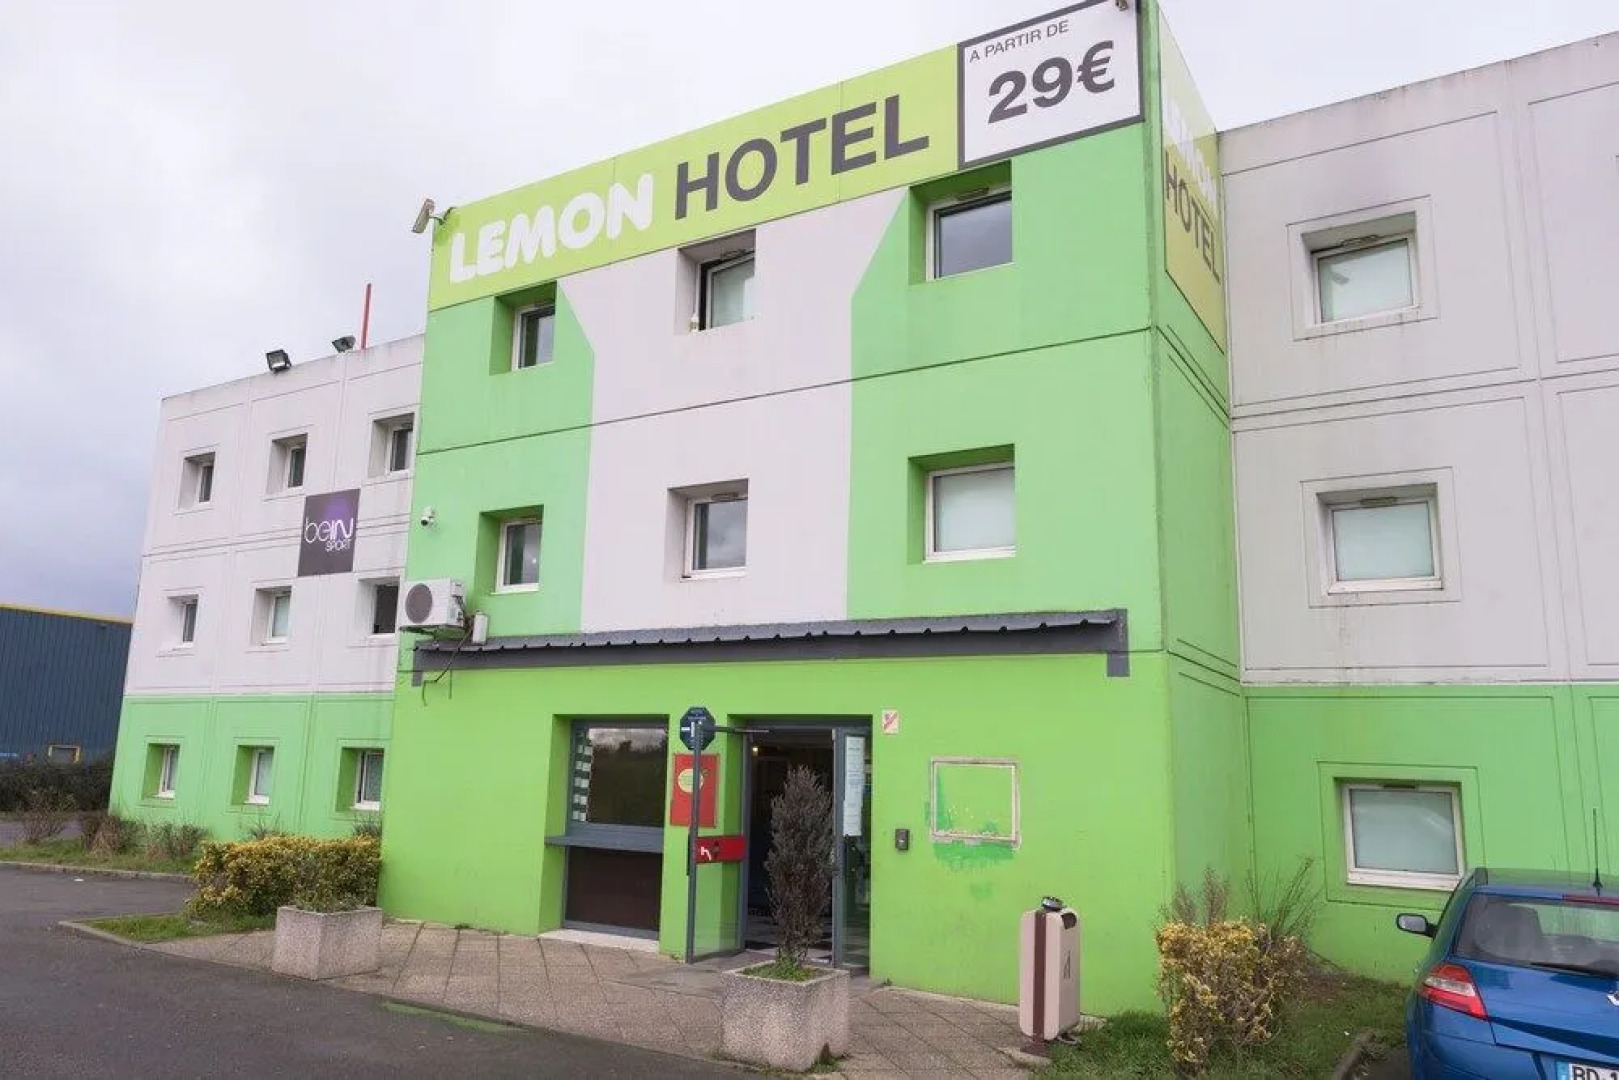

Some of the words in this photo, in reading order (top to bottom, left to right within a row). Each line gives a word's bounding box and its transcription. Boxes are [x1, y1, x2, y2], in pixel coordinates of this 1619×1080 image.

[969, 49, 980, 63] A
[985, 29, 1042, 58] PARTIR
[1047, 20, 1069, 37] DE
[988, 40, 1115, 124] 29€
[450, 173, 654, 284] LEMON
[675, 94, 930, 220] HOTEL
[1166, 150, 1221, 285] HOTEL
